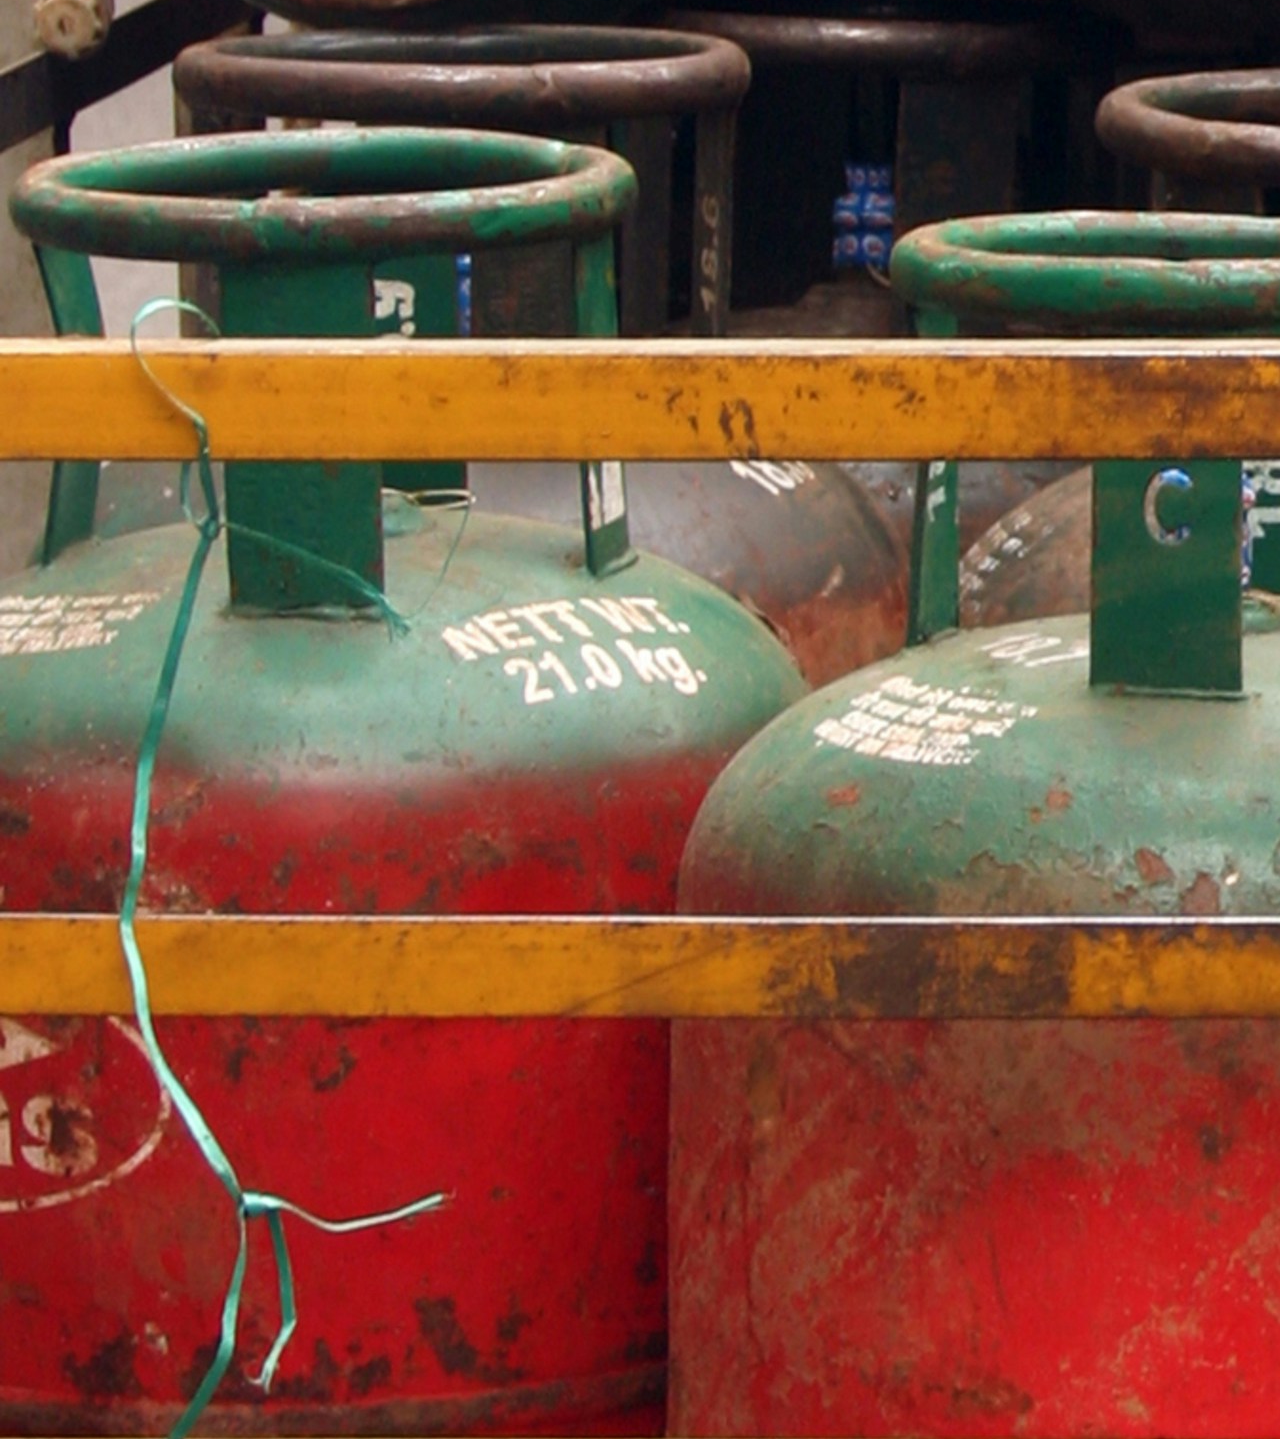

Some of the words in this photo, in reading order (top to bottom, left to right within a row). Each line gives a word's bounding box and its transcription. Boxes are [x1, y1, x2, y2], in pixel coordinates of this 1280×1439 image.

[442, 598, 594, 661] NETT
[578, 597, 691, 634] WT.
[503, 643, 623, 704] 21.0
[615, 638, 708, 694] kg.
